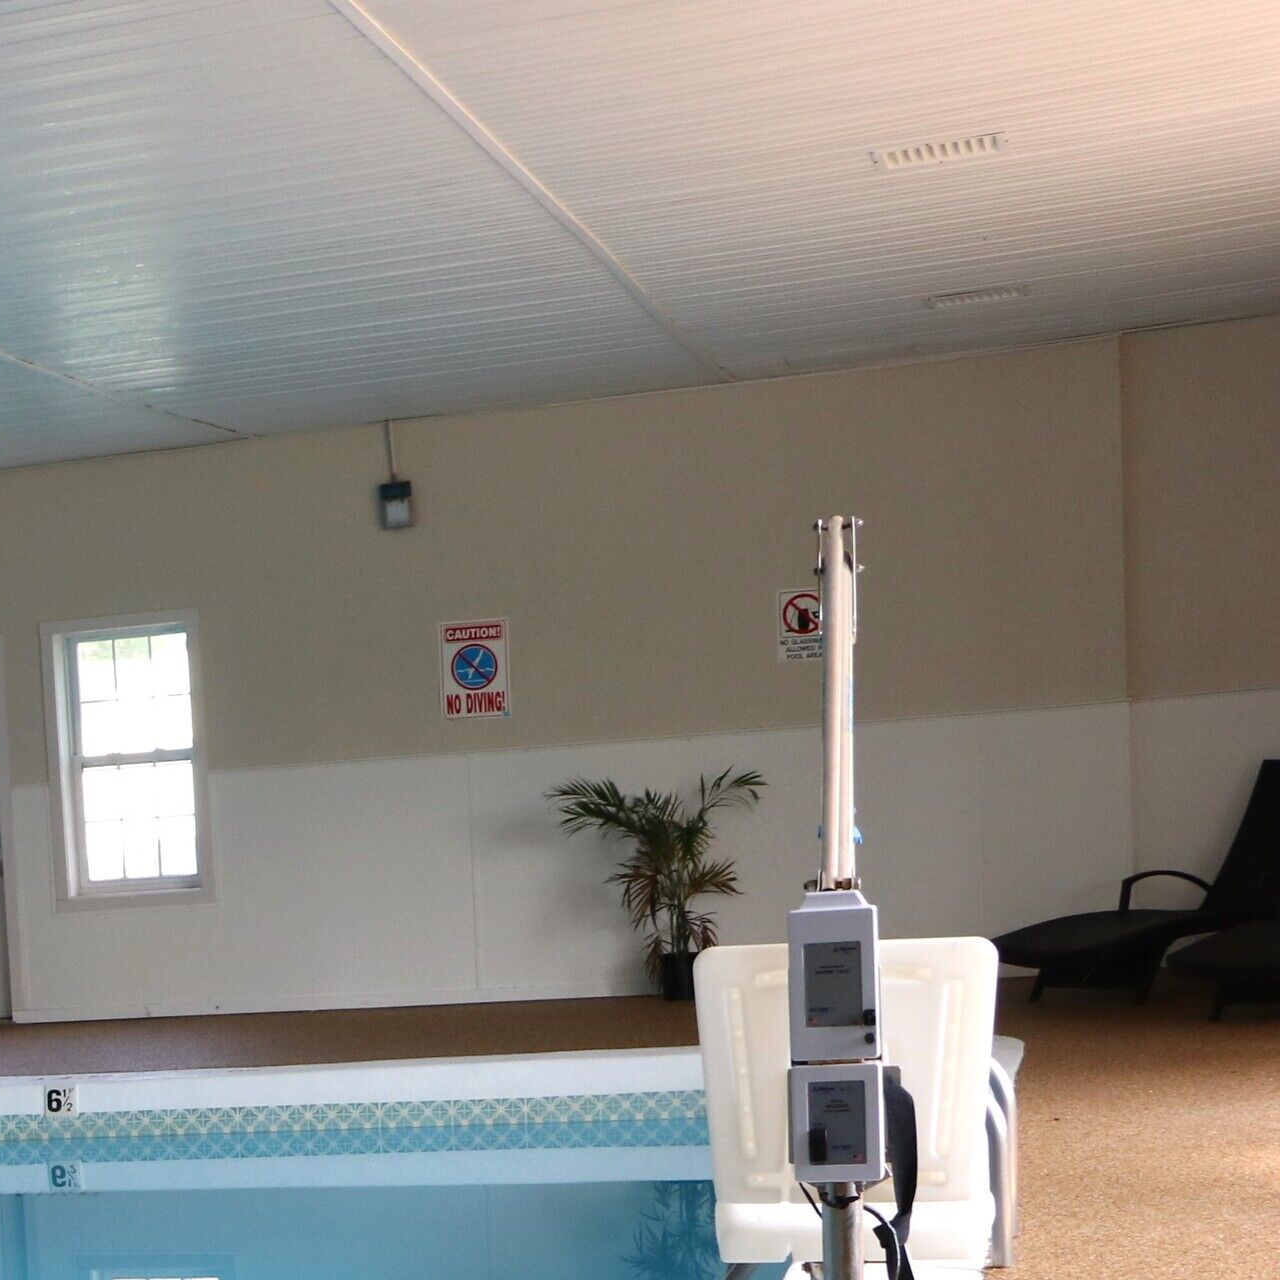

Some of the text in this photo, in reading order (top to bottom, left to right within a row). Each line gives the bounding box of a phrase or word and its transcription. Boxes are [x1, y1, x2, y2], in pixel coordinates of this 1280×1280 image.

[446, 626, 501, 640] CAUTION!
[446, 691, 506, 714] NO DIVING!
